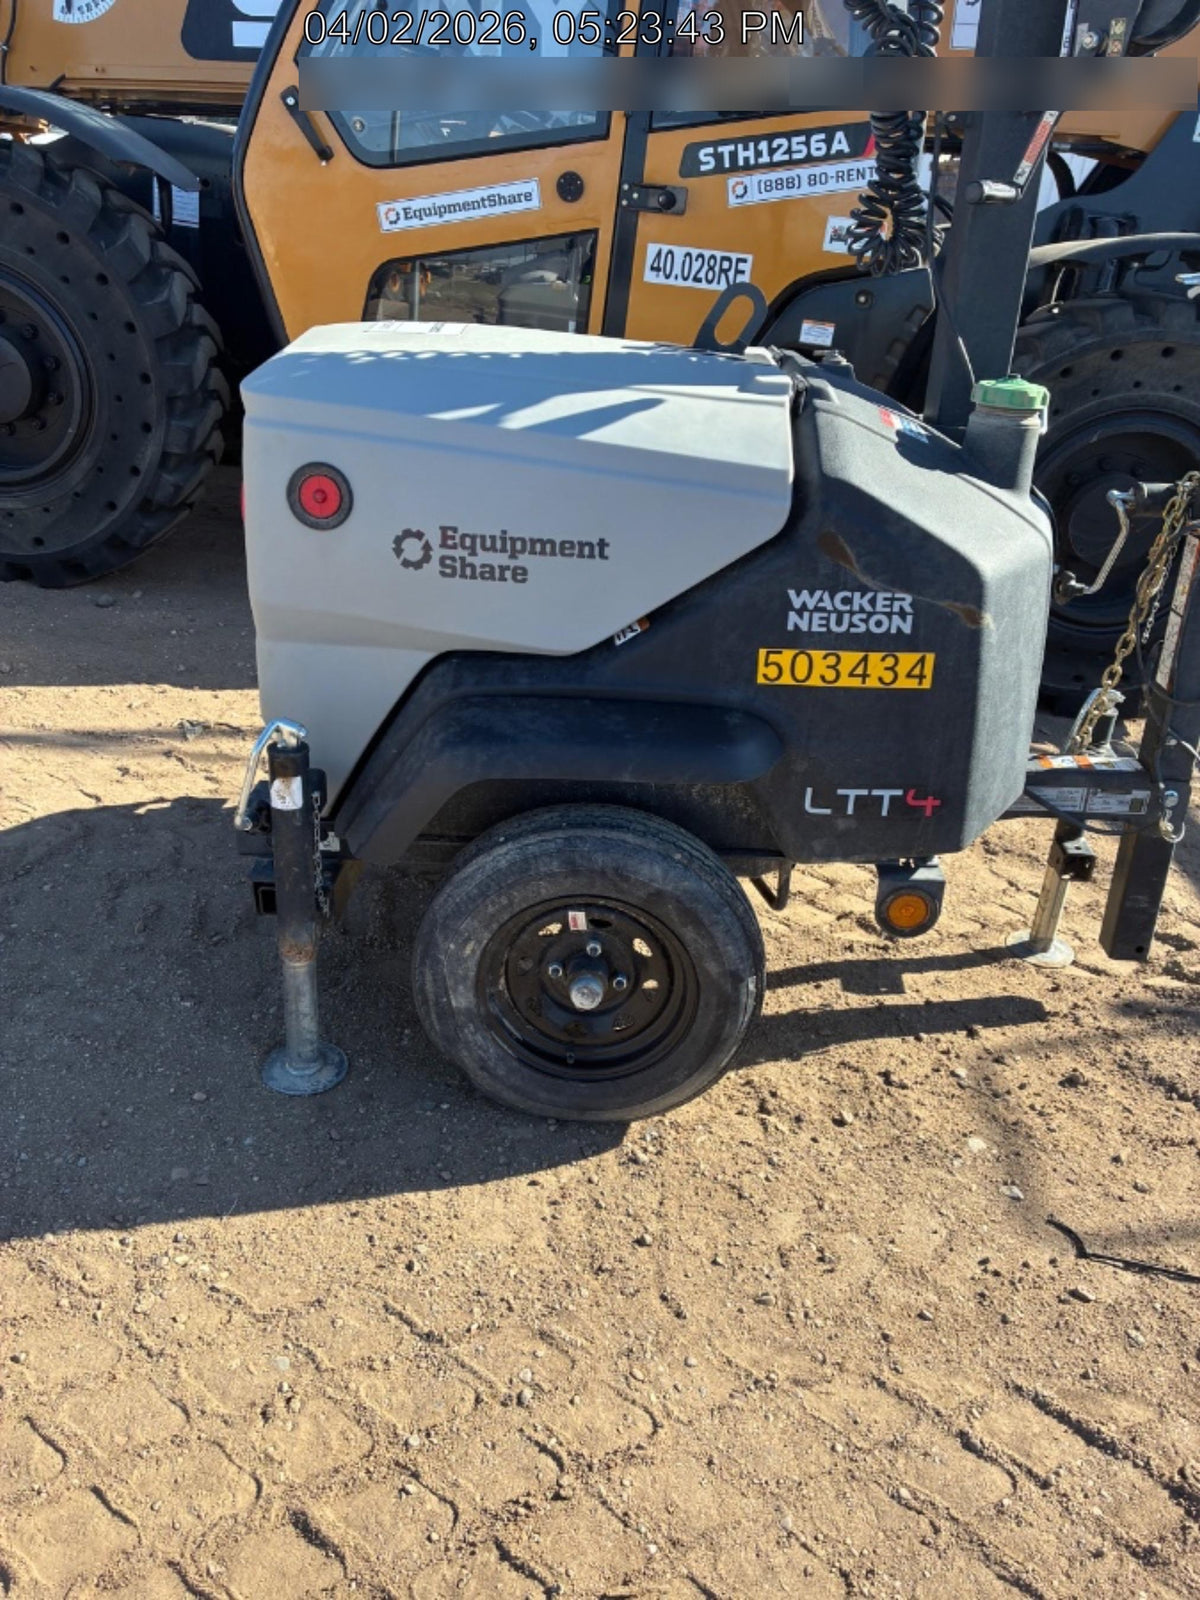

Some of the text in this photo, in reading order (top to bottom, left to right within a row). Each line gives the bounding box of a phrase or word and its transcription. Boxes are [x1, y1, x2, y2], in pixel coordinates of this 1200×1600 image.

[698, 131, 850, 172] STH1256A
[758, 174, 801, 195] (888)
[402, 191, 533, 221] EquipmentShare
[438, 525, 610, 560] Equipment
[438, 555, 529, 584] Share
[787, 589, 914, 613] WACKER
[787, 611, 913, 634] NEUSON
[762, 650, 927, 687] 503434
[805, 787, 941, 817] LTT4
